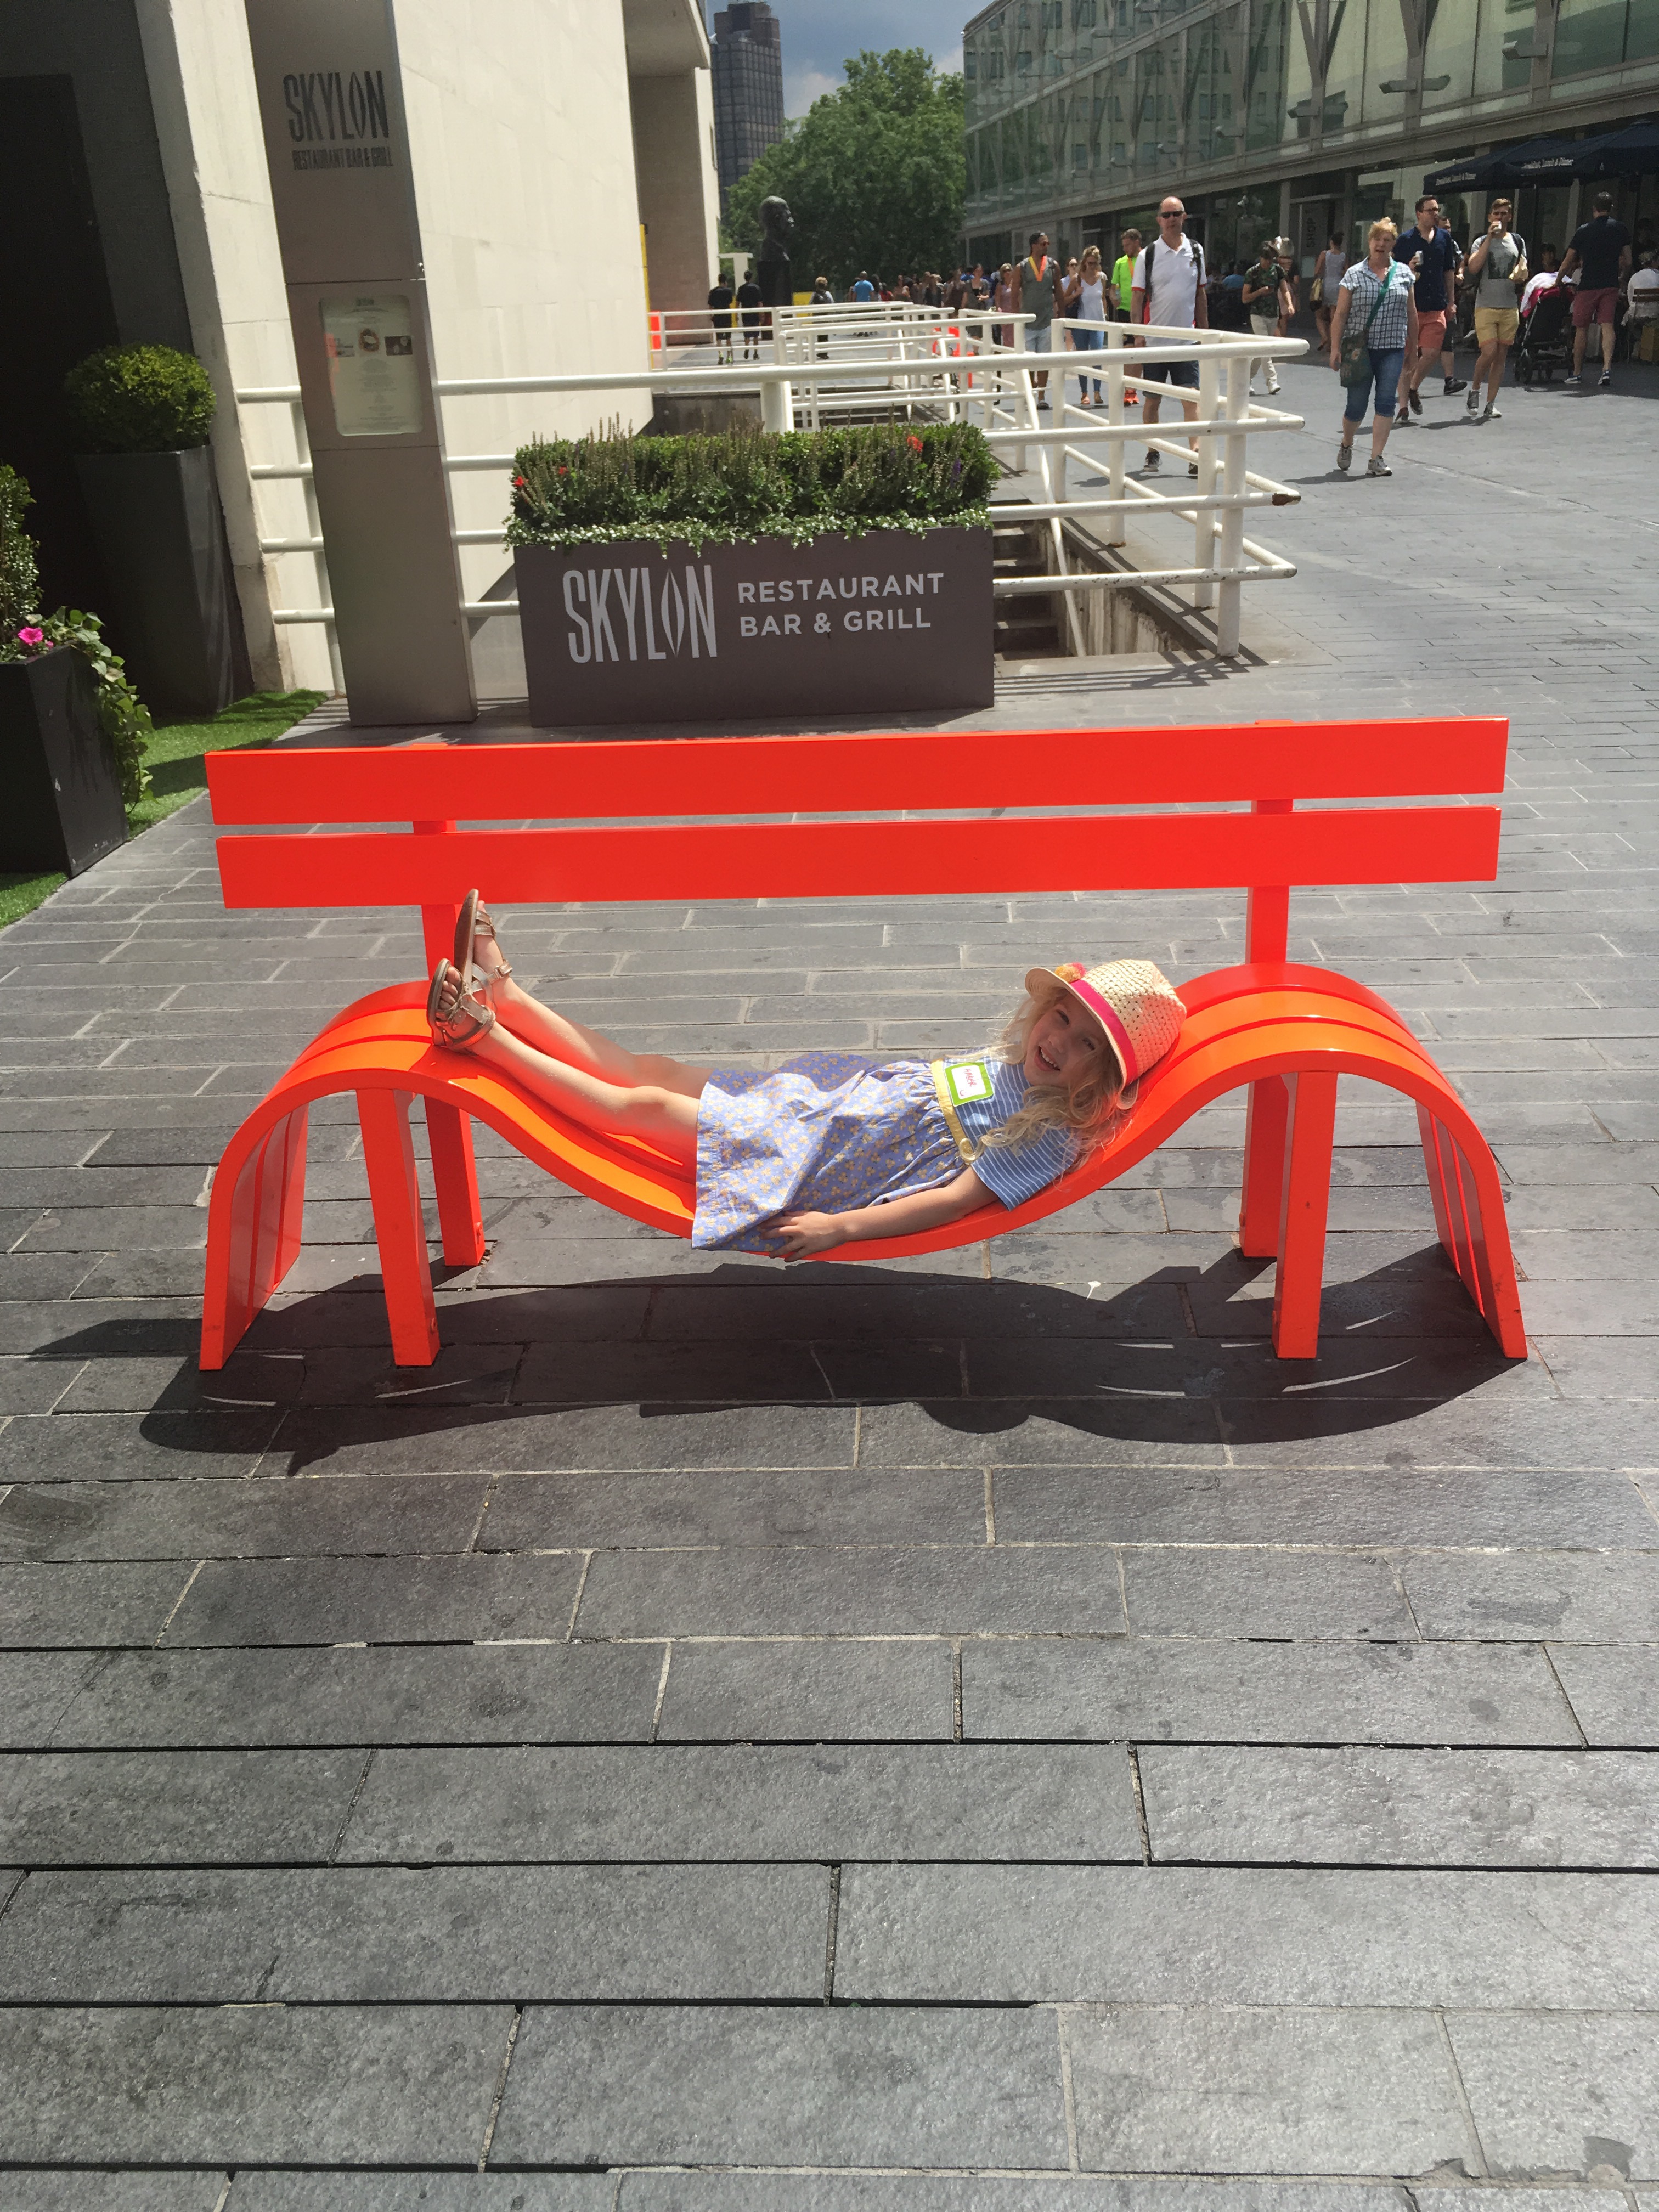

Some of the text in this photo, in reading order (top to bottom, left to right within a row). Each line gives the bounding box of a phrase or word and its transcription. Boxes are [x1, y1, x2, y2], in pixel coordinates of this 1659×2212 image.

[283, 70, 389, 142] SKYLON
[738, 573, 944, 603] RESTAURANT
[562, 565, 717, 663] SKYLON
[740, 608, 931, 637] BAR & GRILL
